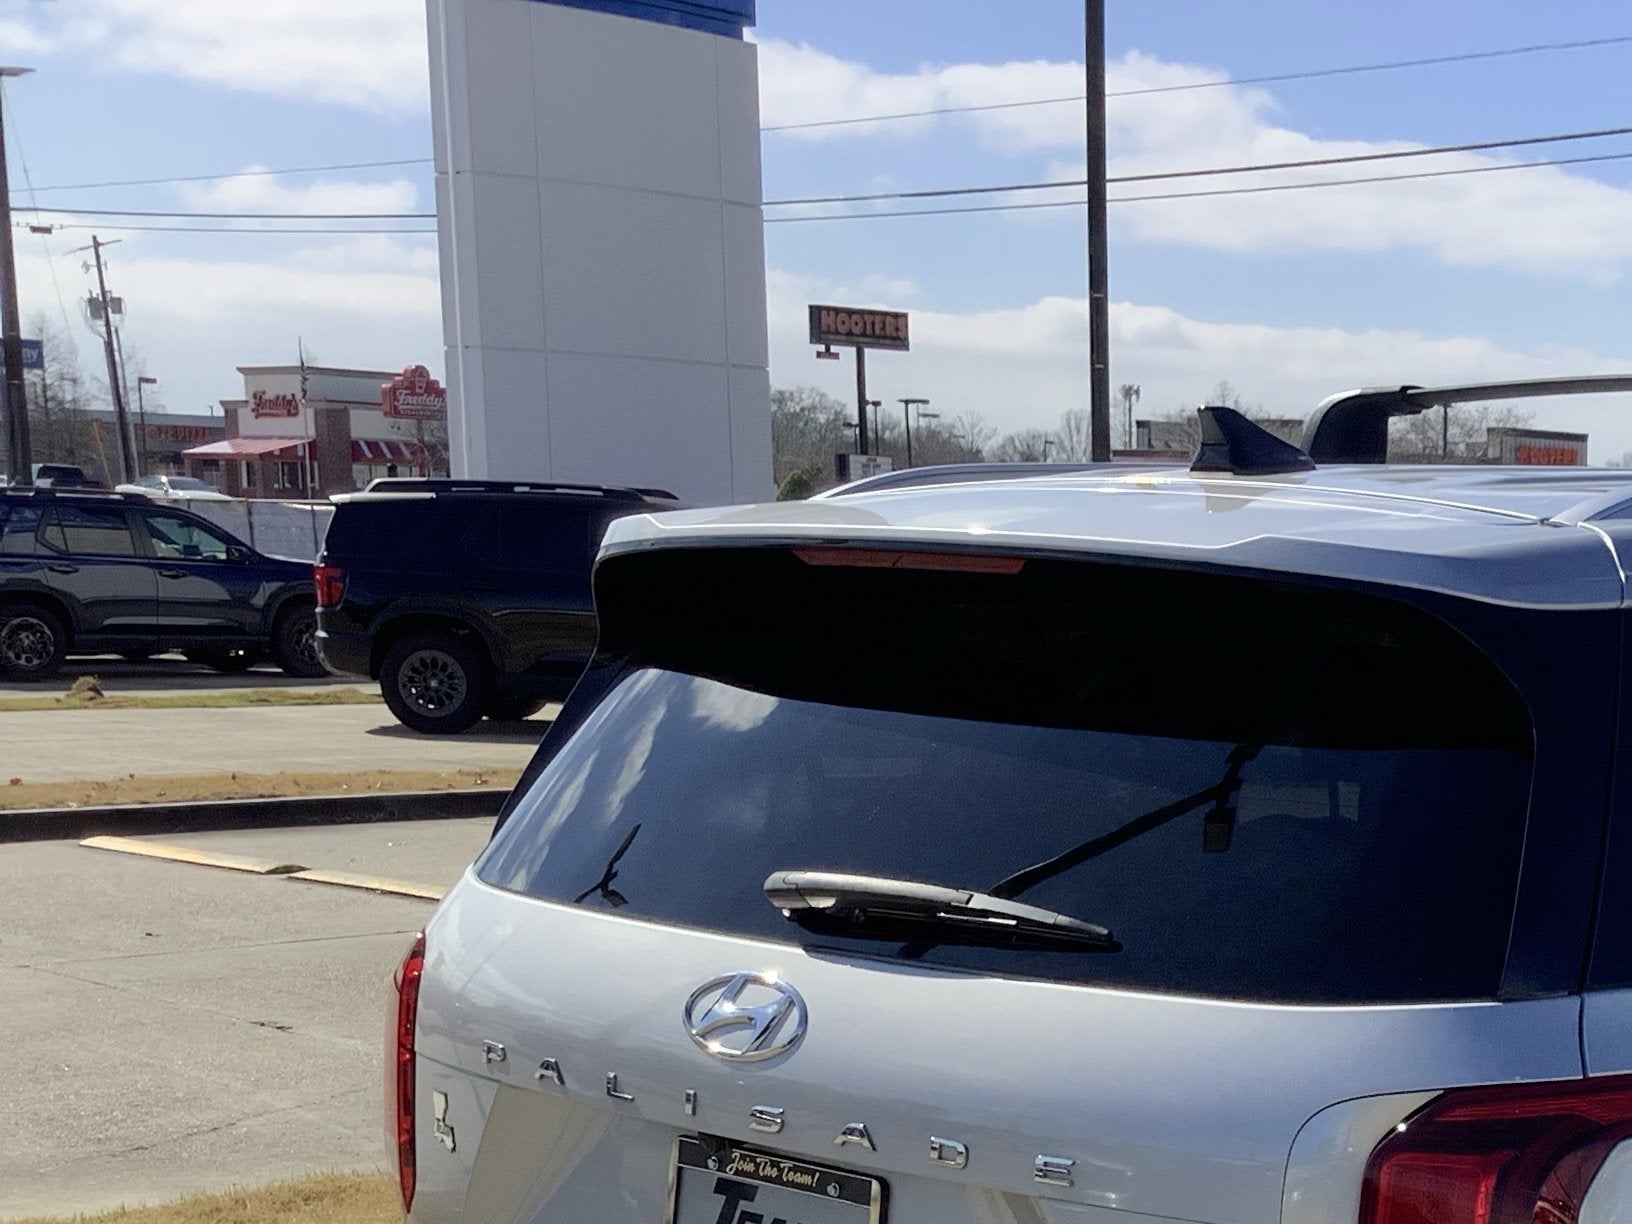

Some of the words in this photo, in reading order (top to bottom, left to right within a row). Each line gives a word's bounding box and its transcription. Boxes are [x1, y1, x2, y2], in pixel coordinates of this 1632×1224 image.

[820, 310, 907, 340] HOOTERS
[482, 1040, 1076, 1187] PALISADE
[725, 1152, 755, 1175] Join
[756, 1157, 779, 1178] The
[780, 1163, 819, 1187] Team!
